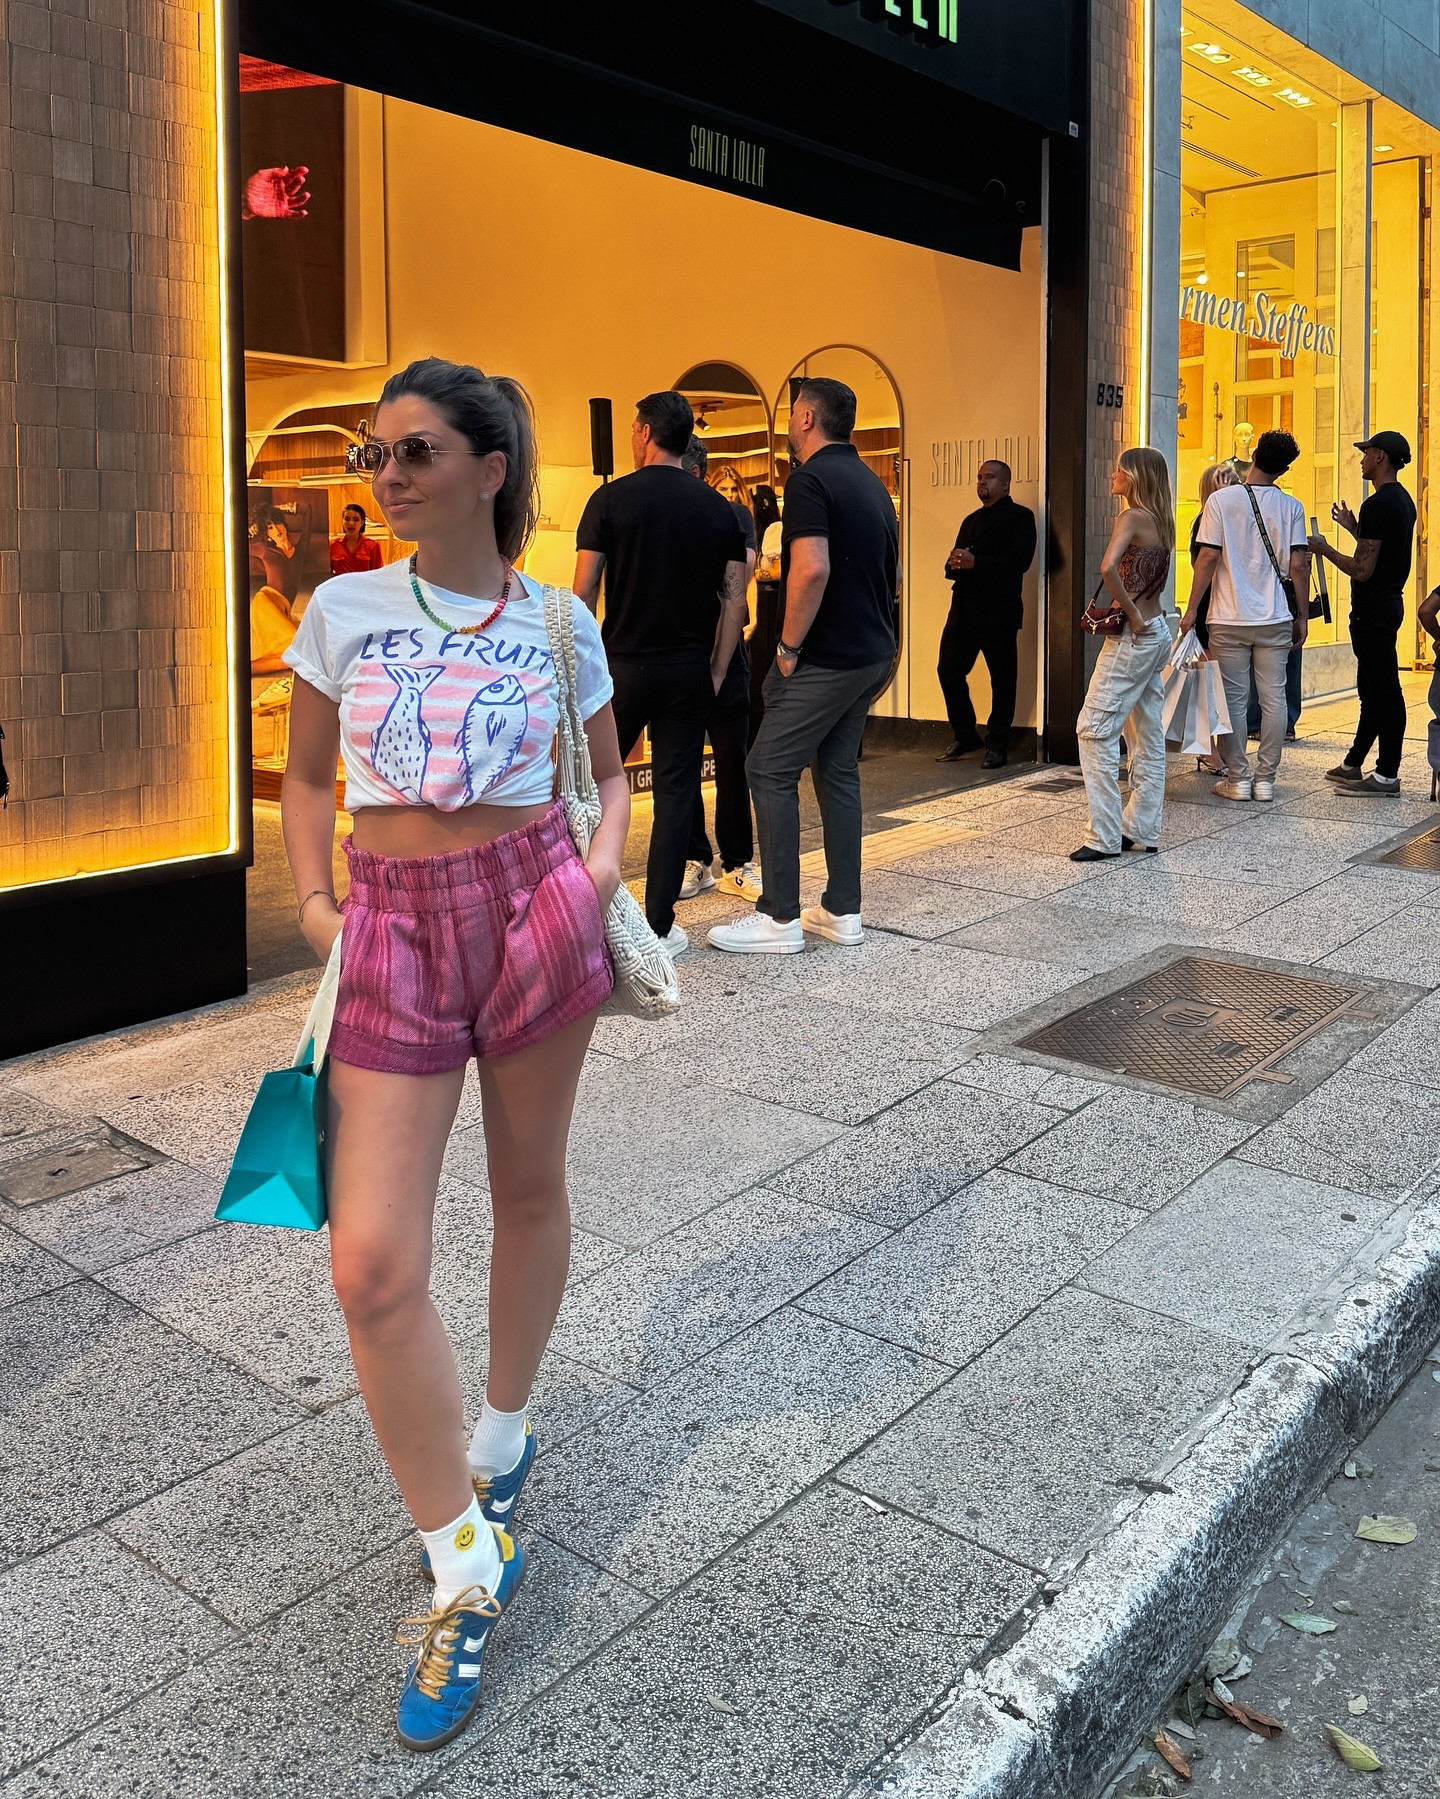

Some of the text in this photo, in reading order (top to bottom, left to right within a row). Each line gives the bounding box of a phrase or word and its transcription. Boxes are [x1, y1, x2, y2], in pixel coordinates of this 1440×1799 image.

[689, 124, 765, 188] SANTA LOLLA
[1179, 286, 1335, 359] rmen Steffens
[1096, 382, 1123, 408] 835
[360, 628, 554, 674] LES FRUIT
